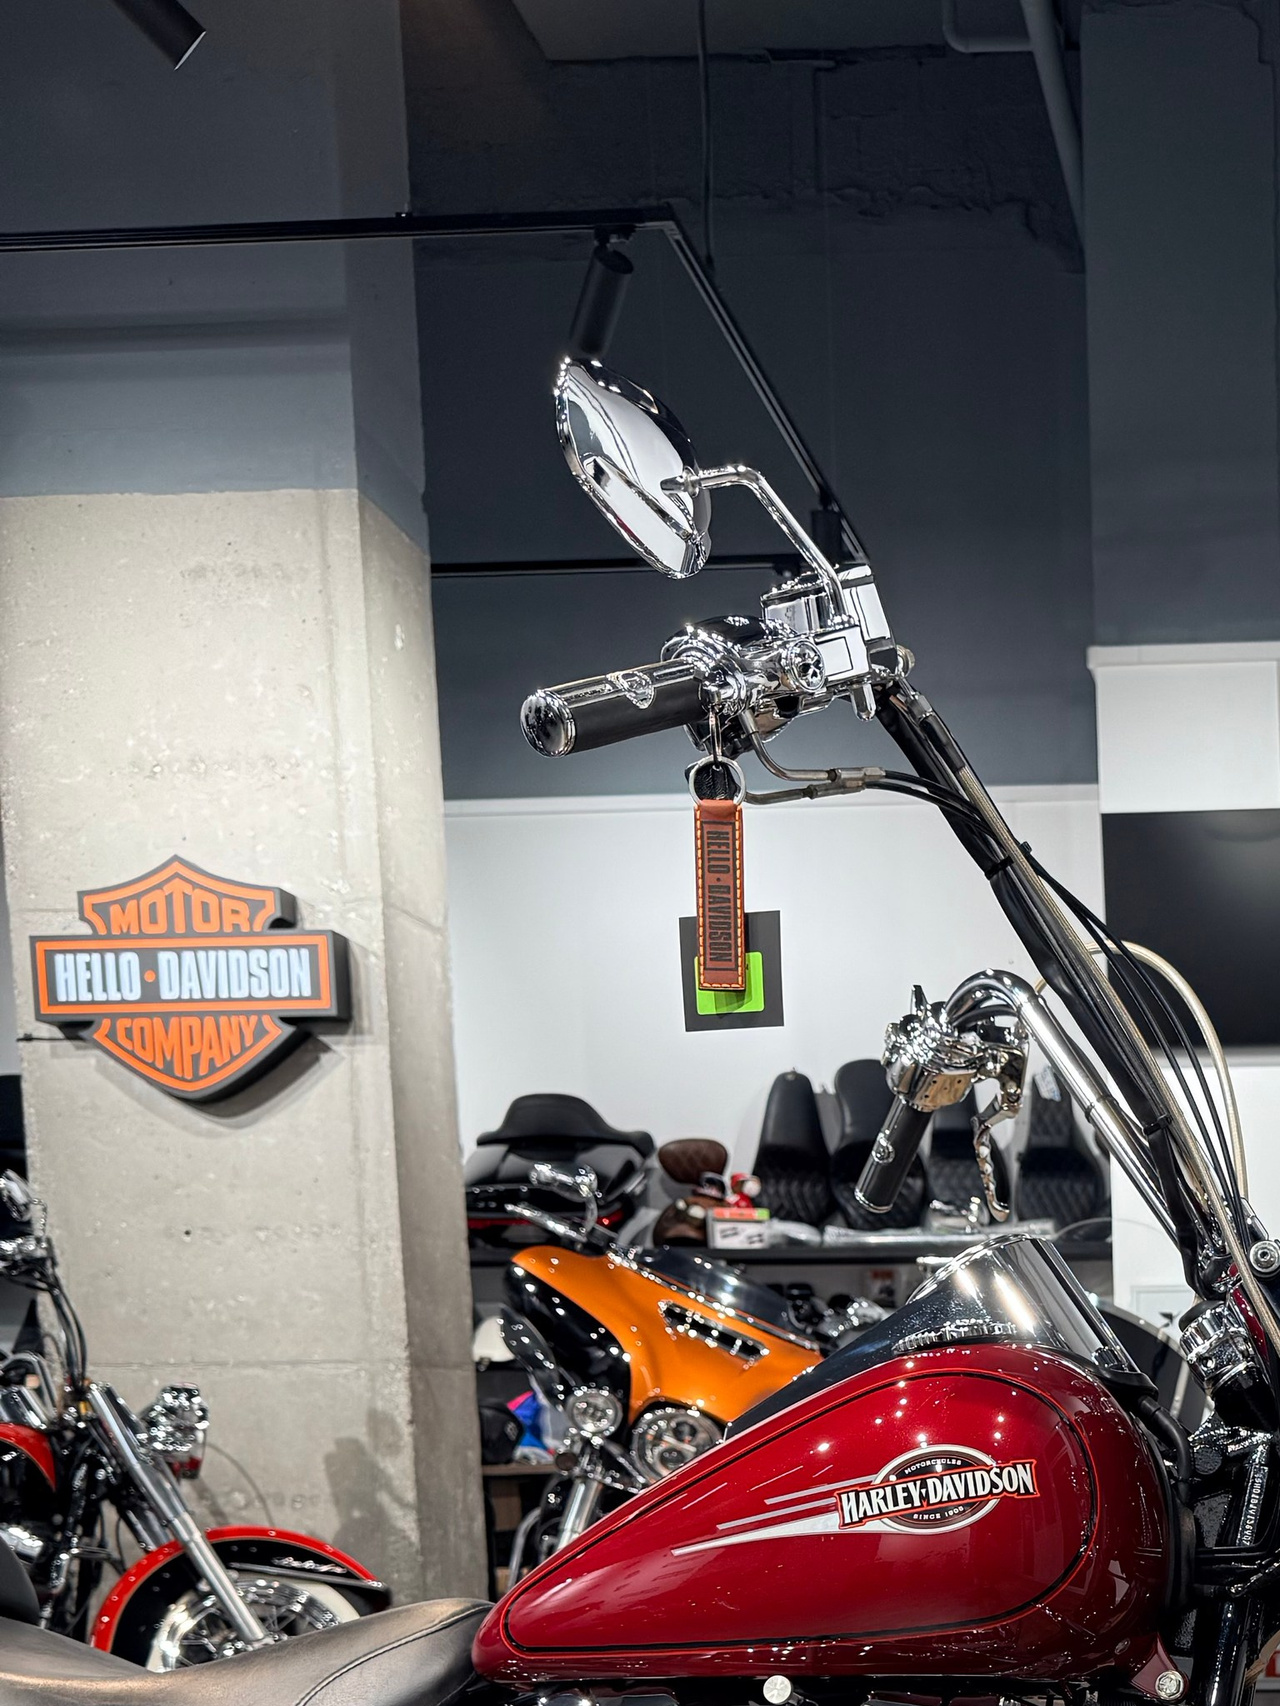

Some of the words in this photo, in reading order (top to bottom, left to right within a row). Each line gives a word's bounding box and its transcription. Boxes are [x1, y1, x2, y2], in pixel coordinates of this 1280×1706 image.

[706, 830, 731, 874] HELLO
[110, 877, 251, 934] MOTOR
[707, 884, 732, 963] DAVIDSON
[54, 951, 142, 1002] HELLO
[156, 948, 312, 1000] DAVIDSON
[116, 1014, 258, 1080] COMPANY
[840, 1463, 1035, 1525] HARLEY-DAVIDSON
[904, 1458, 962, 1475] MOTORCYCLES
